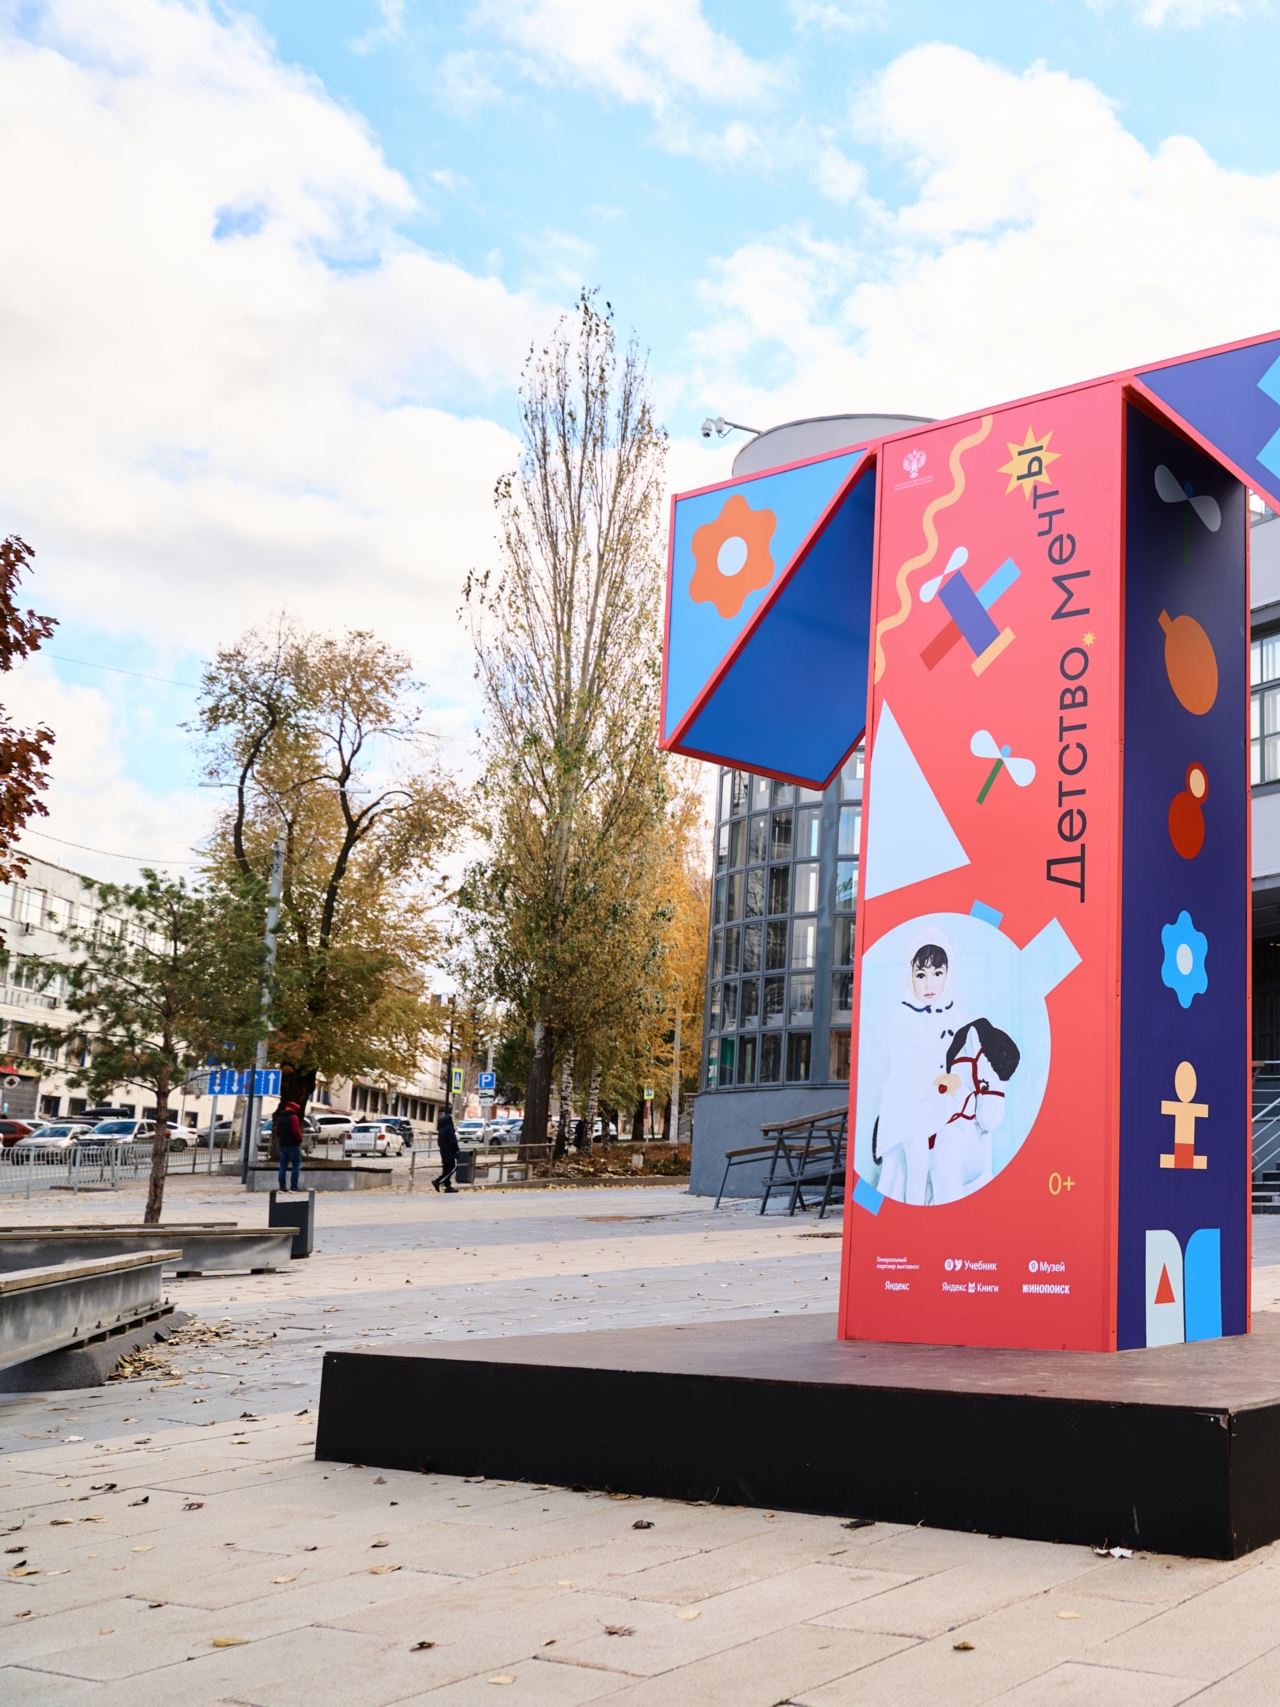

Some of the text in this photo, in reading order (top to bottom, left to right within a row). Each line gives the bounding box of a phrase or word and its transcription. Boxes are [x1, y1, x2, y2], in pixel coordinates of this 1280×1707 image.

[1016, 445, 1091, 903] Детство Мечты
[1049, 1172, 1075, 1195] 0+
[964, 1260, 997, 1271] Учебник
[1039, 1261, 1066, 1274] Музей
[885, 1280, 909, 1291] Яндекс
[942, 1282, 999, 1293] Яндекс Книги
